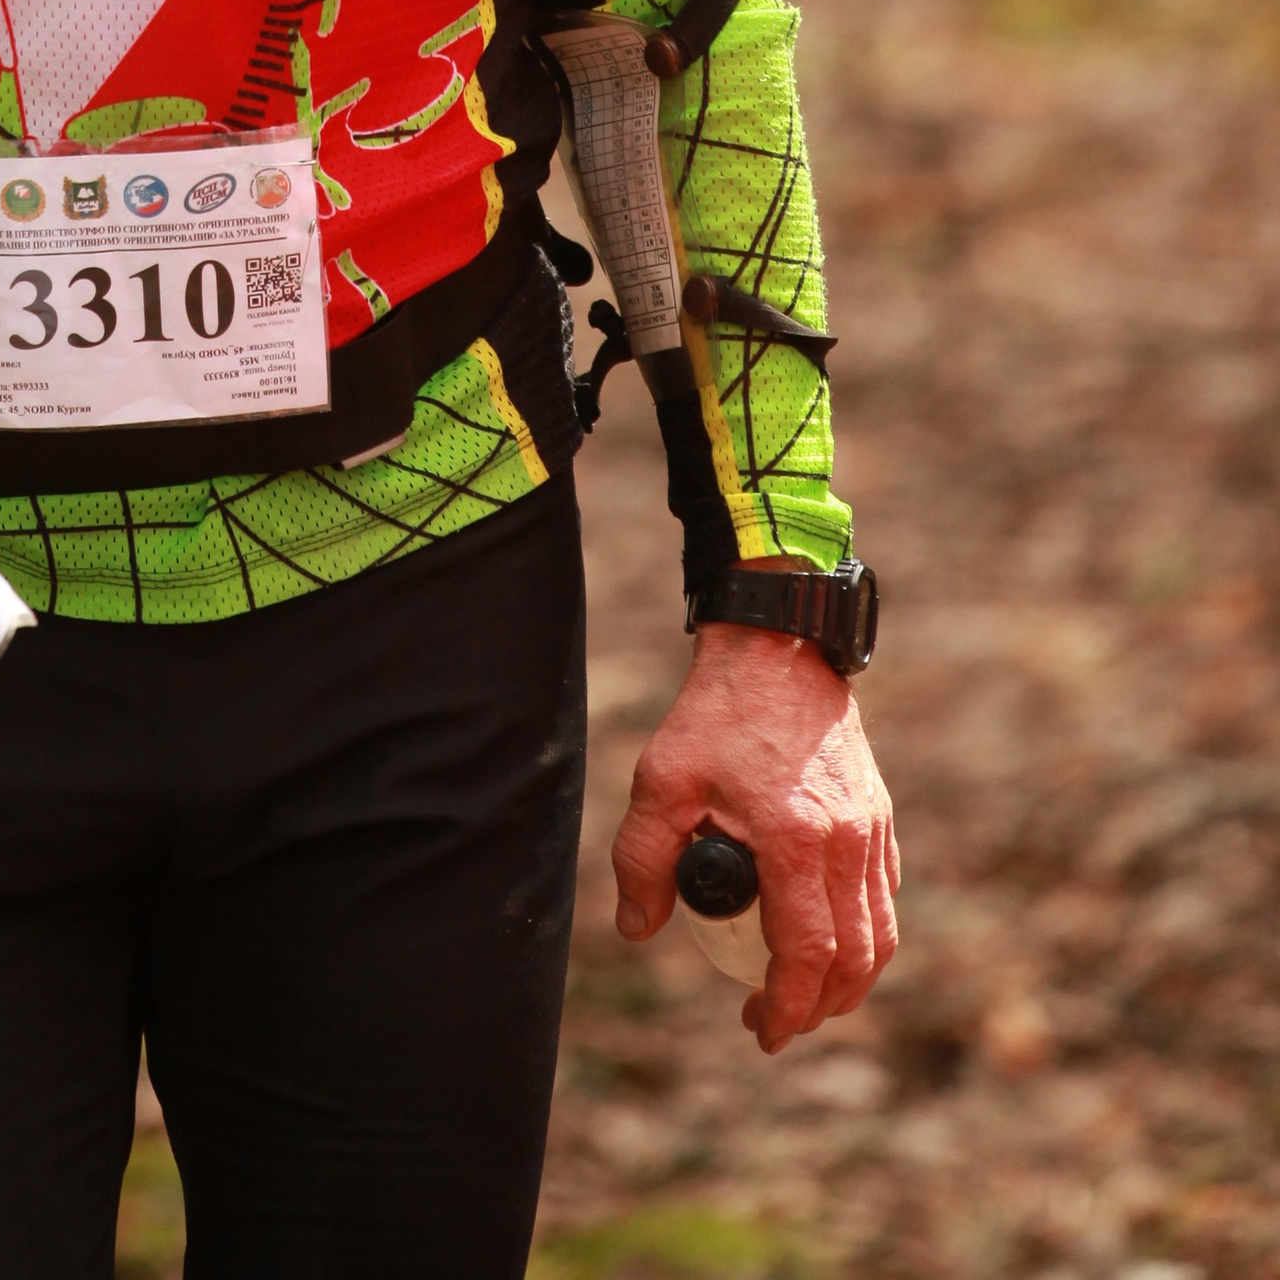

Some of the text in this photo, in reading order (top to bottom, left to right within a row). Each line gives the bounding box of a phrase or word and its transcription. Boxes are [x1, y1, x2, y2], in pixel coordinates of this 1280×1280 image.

[6, 230, 13, 238] И
[15, 228, 77, 239] ПЕРВЕНСТВО
[79, 226, 106, 237] УРФО
[107, 225, 121, 235] ПО
[123, 222, 197, 234] СПОРТИВНОМУ
[199, 213, 290, 230] ОРИЕНТИРОВАНИЮ
[33, 240, 47, 249] ПО
[48, 236, 121, 248] СПОРТИВНОМУ
[124, 232, 217, 245] ОРИЕНТИРОВАНИЮ
[218, 229, 235, 239] «ЗА
[236, 226, 281, 238] УРАЛОМ»
[8, 260, 235, 351] 3310
[161, 340, 295, 361] Коллектив: 45_NORD Курган
[261, 350, 296, 362] Группа:
[203, 363, 297, 382] Номер чипа: 8393333
[259, 375, 298, 386] 16:10:00
[12, 382, 50, 391] 8393333
[231, 386, 298, 400] Иванов Павел
[8, 405, 55, 416] 45_NORD
[57, 404, 92, 415] Курган
